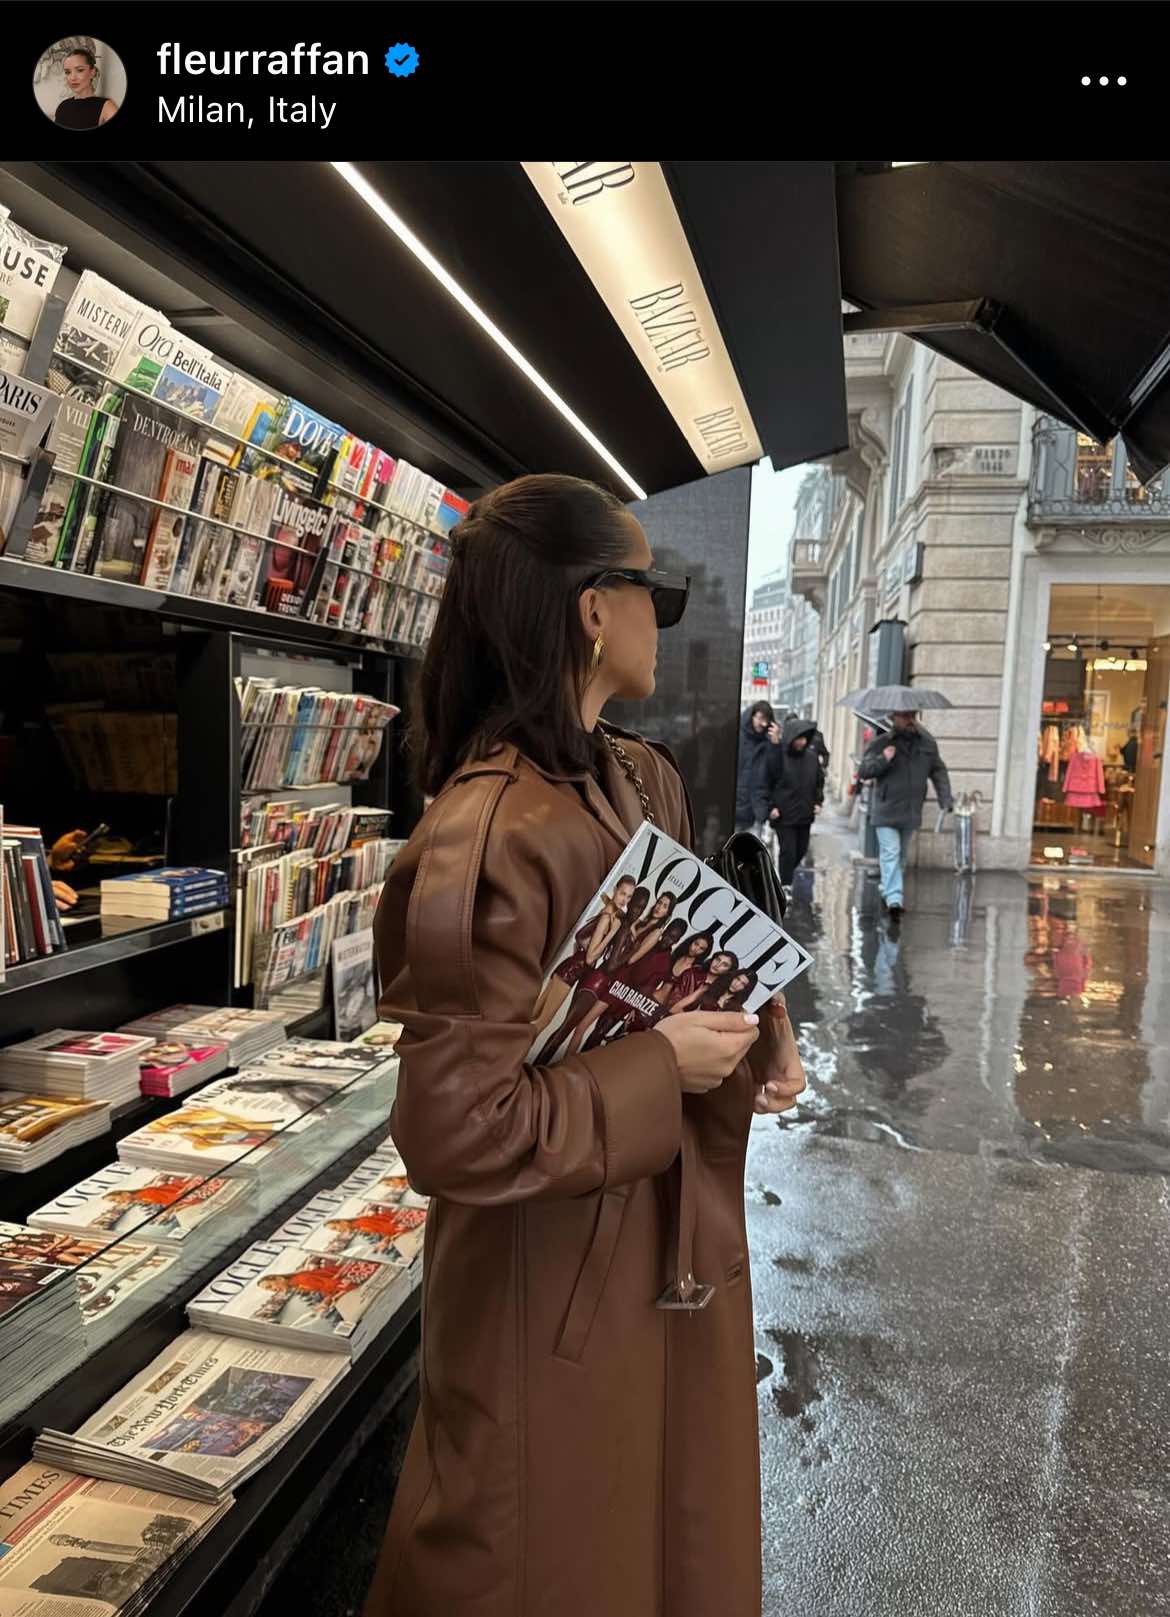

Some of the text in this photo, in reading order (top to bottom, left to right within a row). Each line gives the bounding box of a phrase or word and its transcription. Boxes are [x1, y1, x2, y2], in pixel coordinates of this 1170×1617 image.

[172, 350, 223, 391] Bell'Italia
[636, 832, 807, 992] VOGUE
[609, 980, 660, 1017] CIAO RAGAZZE
[35, 1165, 138, 1217] VOGUE
[270, 1190, 346, 1246] VOGUE
[194, 1242, 287, 1306] VOGUE
[130, 1407, 163, 1432] New
[155, 1378, 191, 1411] York
[181, 1357, 219, 1386] Times
[0, 1470, 60, 1520] TIMES
